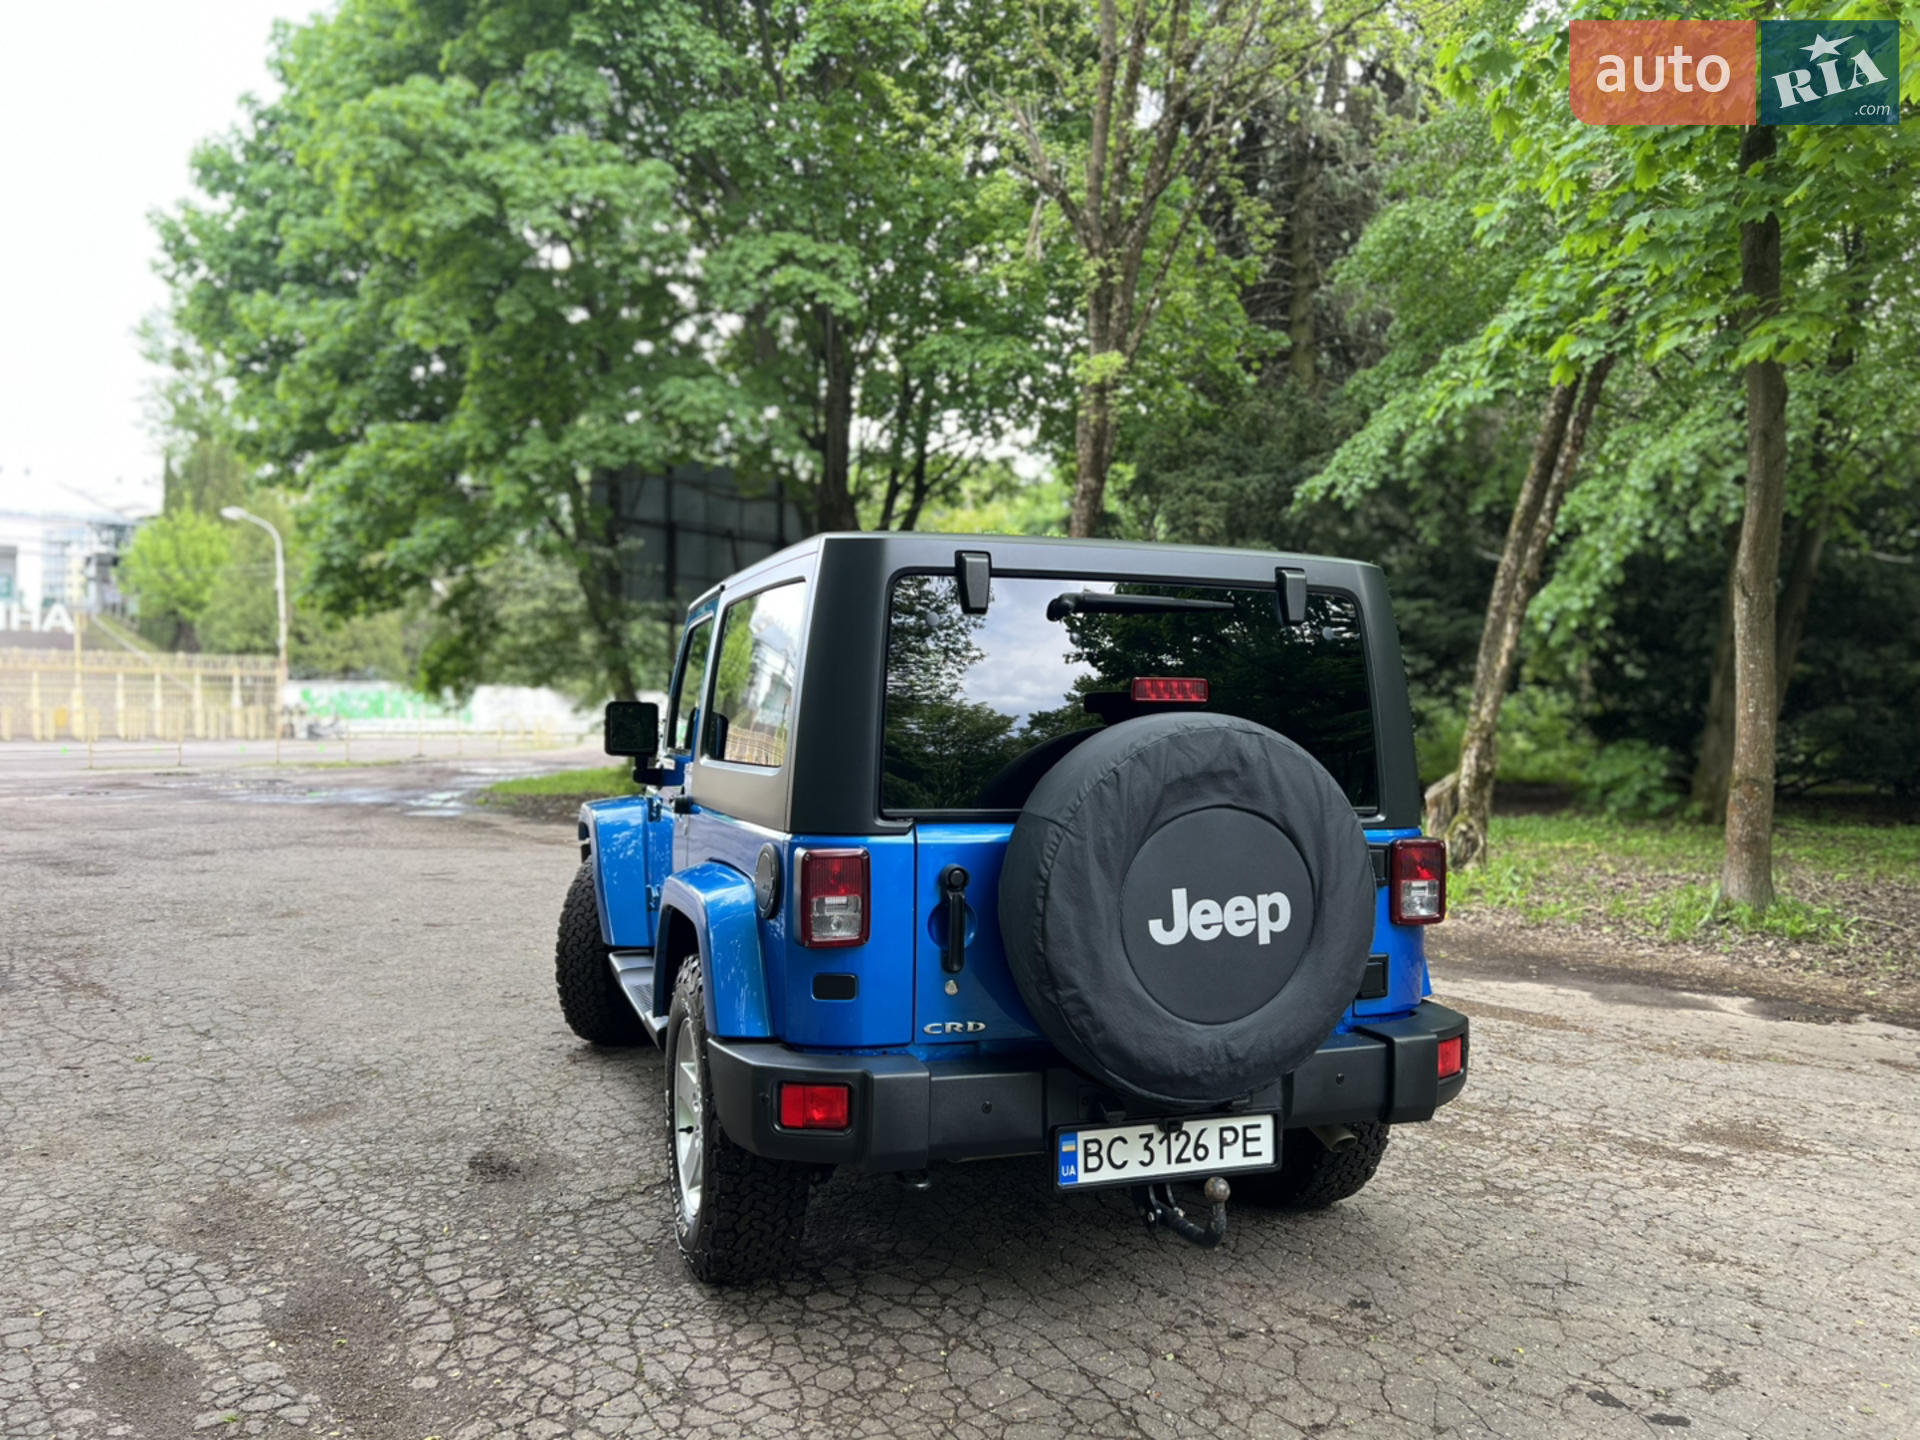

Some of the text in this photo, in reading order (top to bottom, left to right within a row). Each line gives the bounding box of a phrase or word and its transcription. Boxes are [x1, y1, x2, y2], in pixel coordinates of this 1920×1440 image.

[1148, 887, 1292, 946] Jeep
[923, 1021, 986, 1035] CRD
[1061, 1165, 1077, 1177] UA
